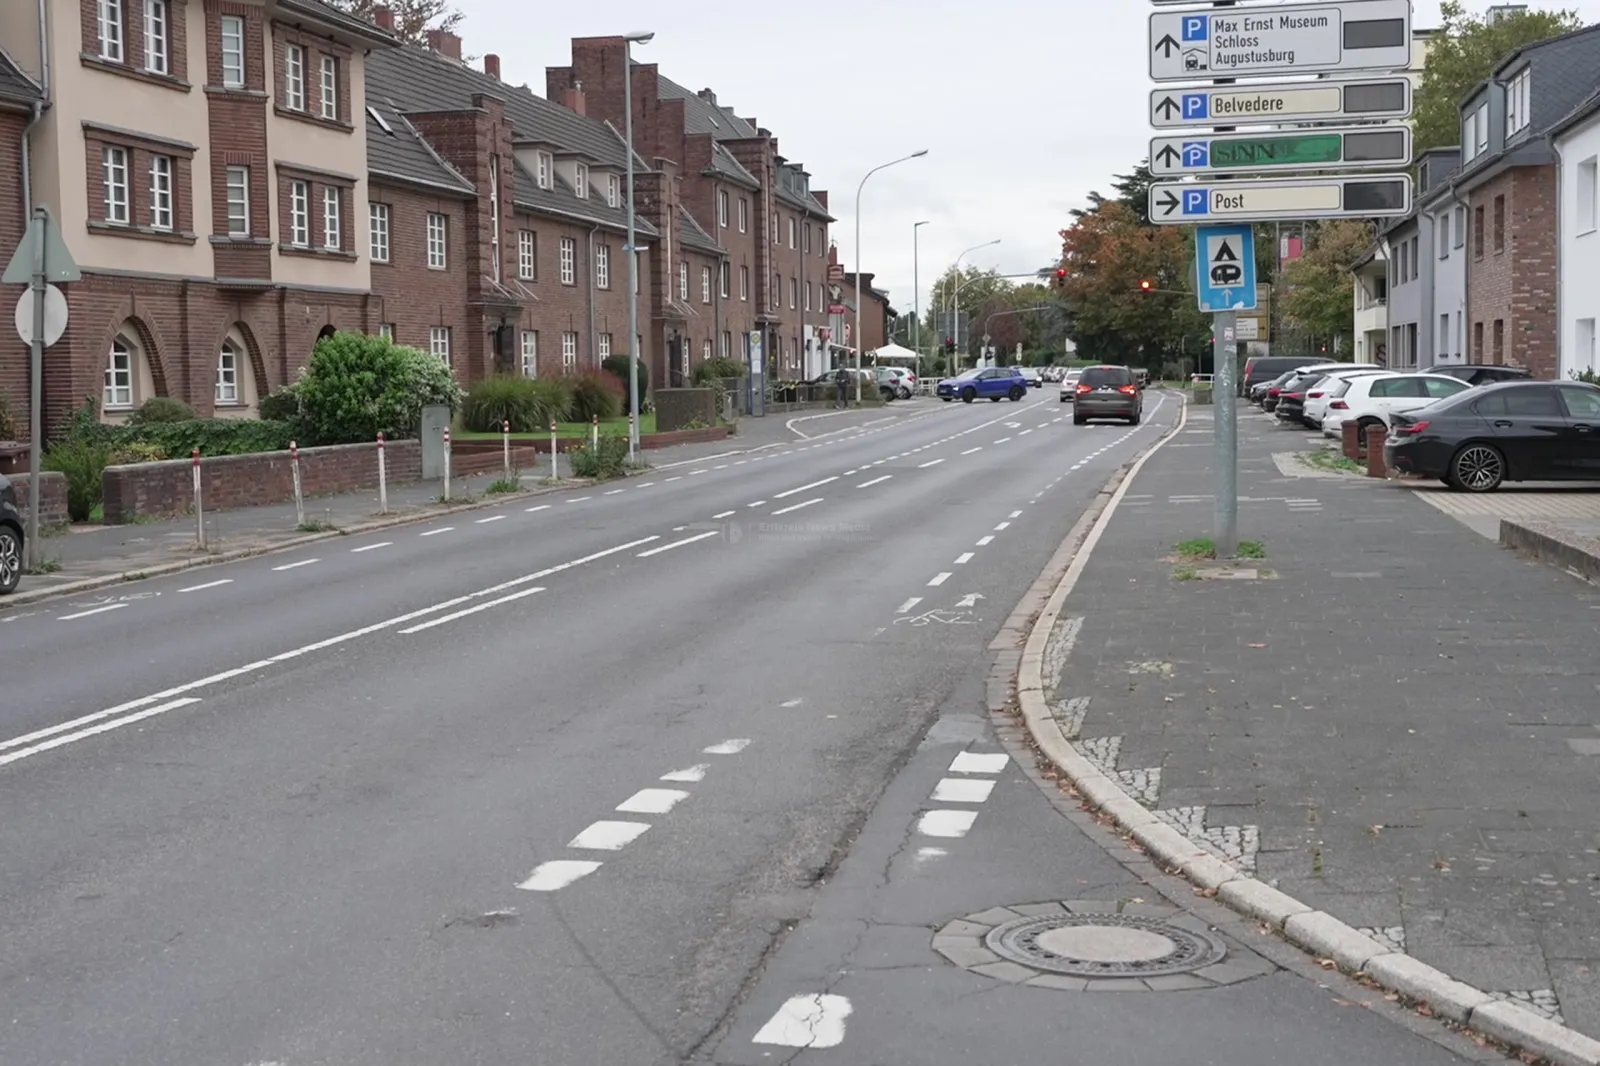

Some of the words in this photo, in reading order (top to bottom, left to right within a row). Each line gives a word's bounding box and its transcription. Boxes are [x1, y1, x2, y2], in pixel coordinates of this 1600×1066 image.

[1188, 19, 1201, 38] P
[1215, 19, 1238, 33] Max
[1243, 17, 1274, 31] Ernst
[1279, 16, 1328, 30] Museum
[1215, 35, 1259, 49] Schloss
[1215, 49, 1295, 67] Augustusburg
[1188, 97, 1201, 116] P
[1215, 98, 1284, 114] Belvedere
[1190, 150, 1201, 166] P
[1188, 193, 1201, 212] P
[1215, 194, 1244, 208] Post
